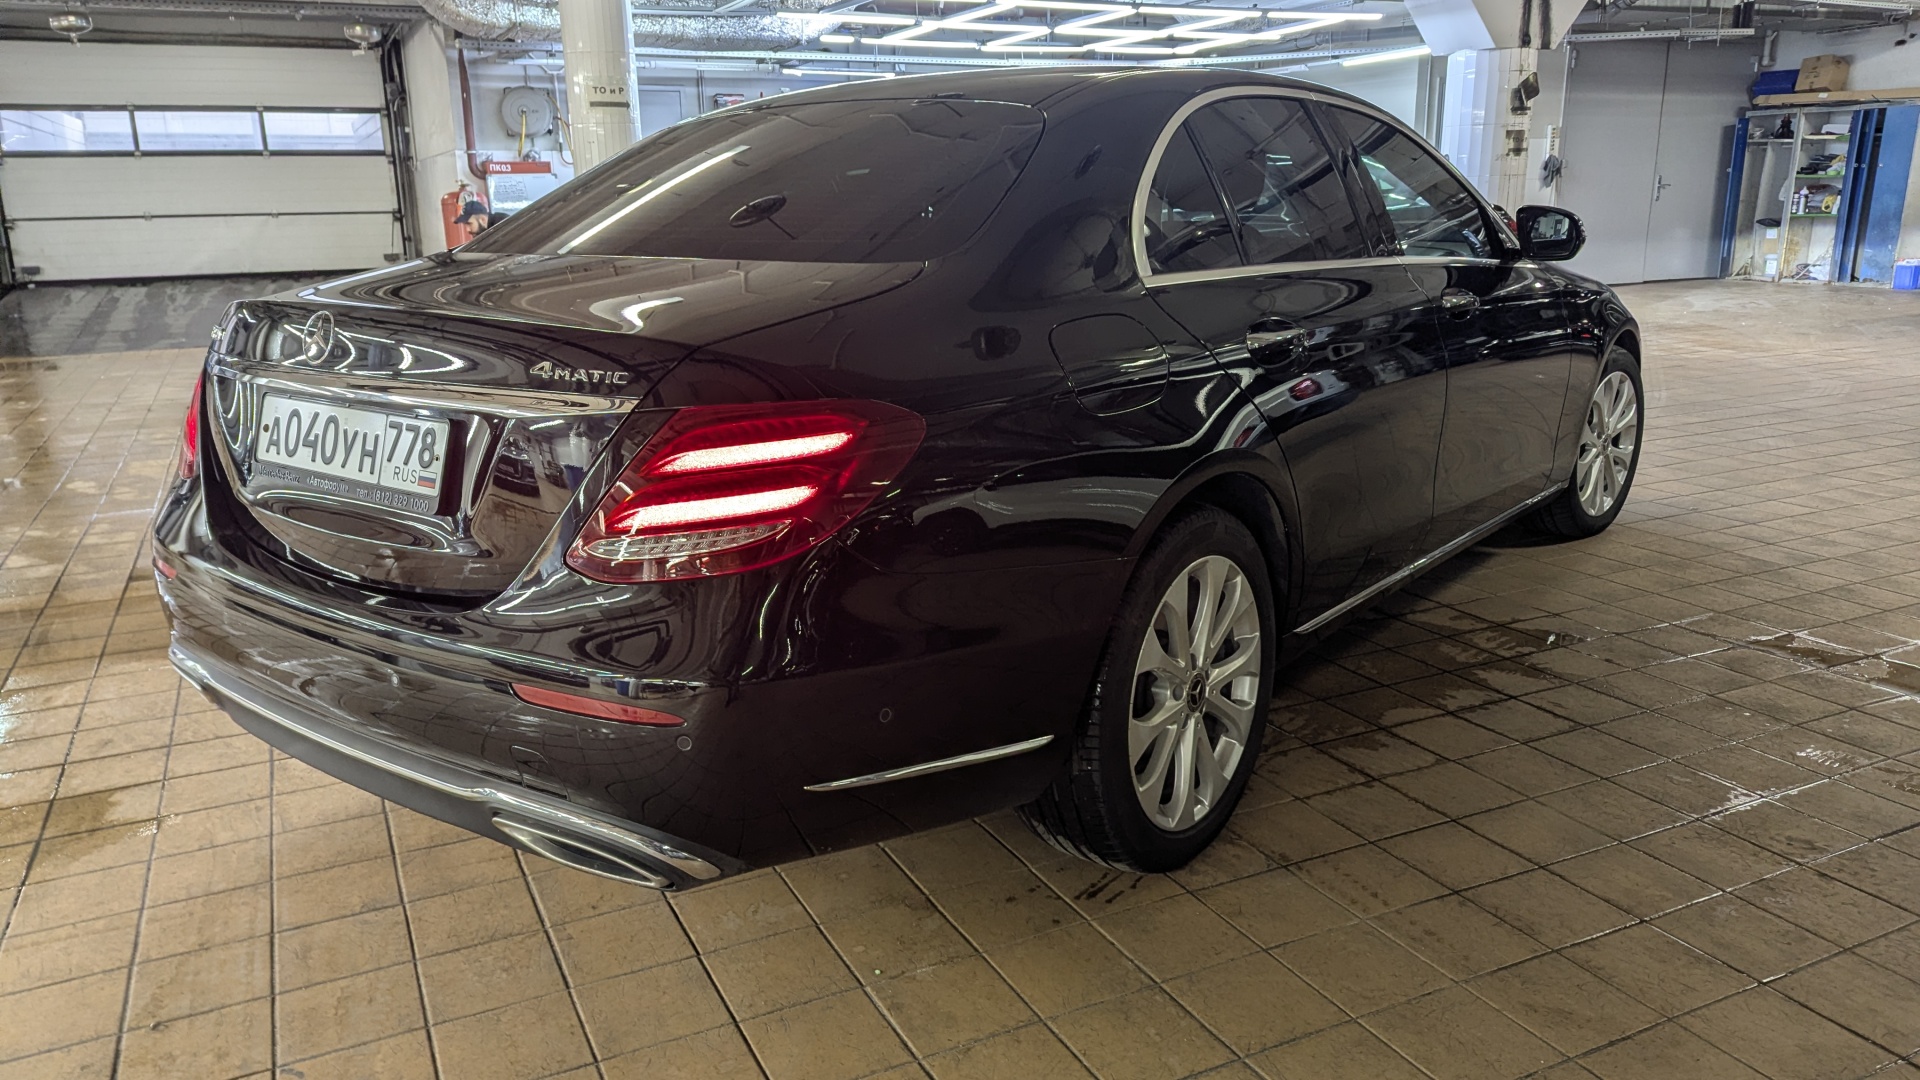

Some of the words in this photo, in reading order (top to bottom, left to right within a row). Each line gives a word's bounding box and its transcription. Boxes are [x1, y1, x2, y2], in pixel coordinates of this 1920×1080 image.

[529, 361, 629, 384] 4MATIC
[386, 420, 437, 469] 778
[392, 467, 418, 484] RUS
[373, 488, 393, 506] (812)
[393, 494, 408, 508] 329
[410, 498, 429, 513] 1000
